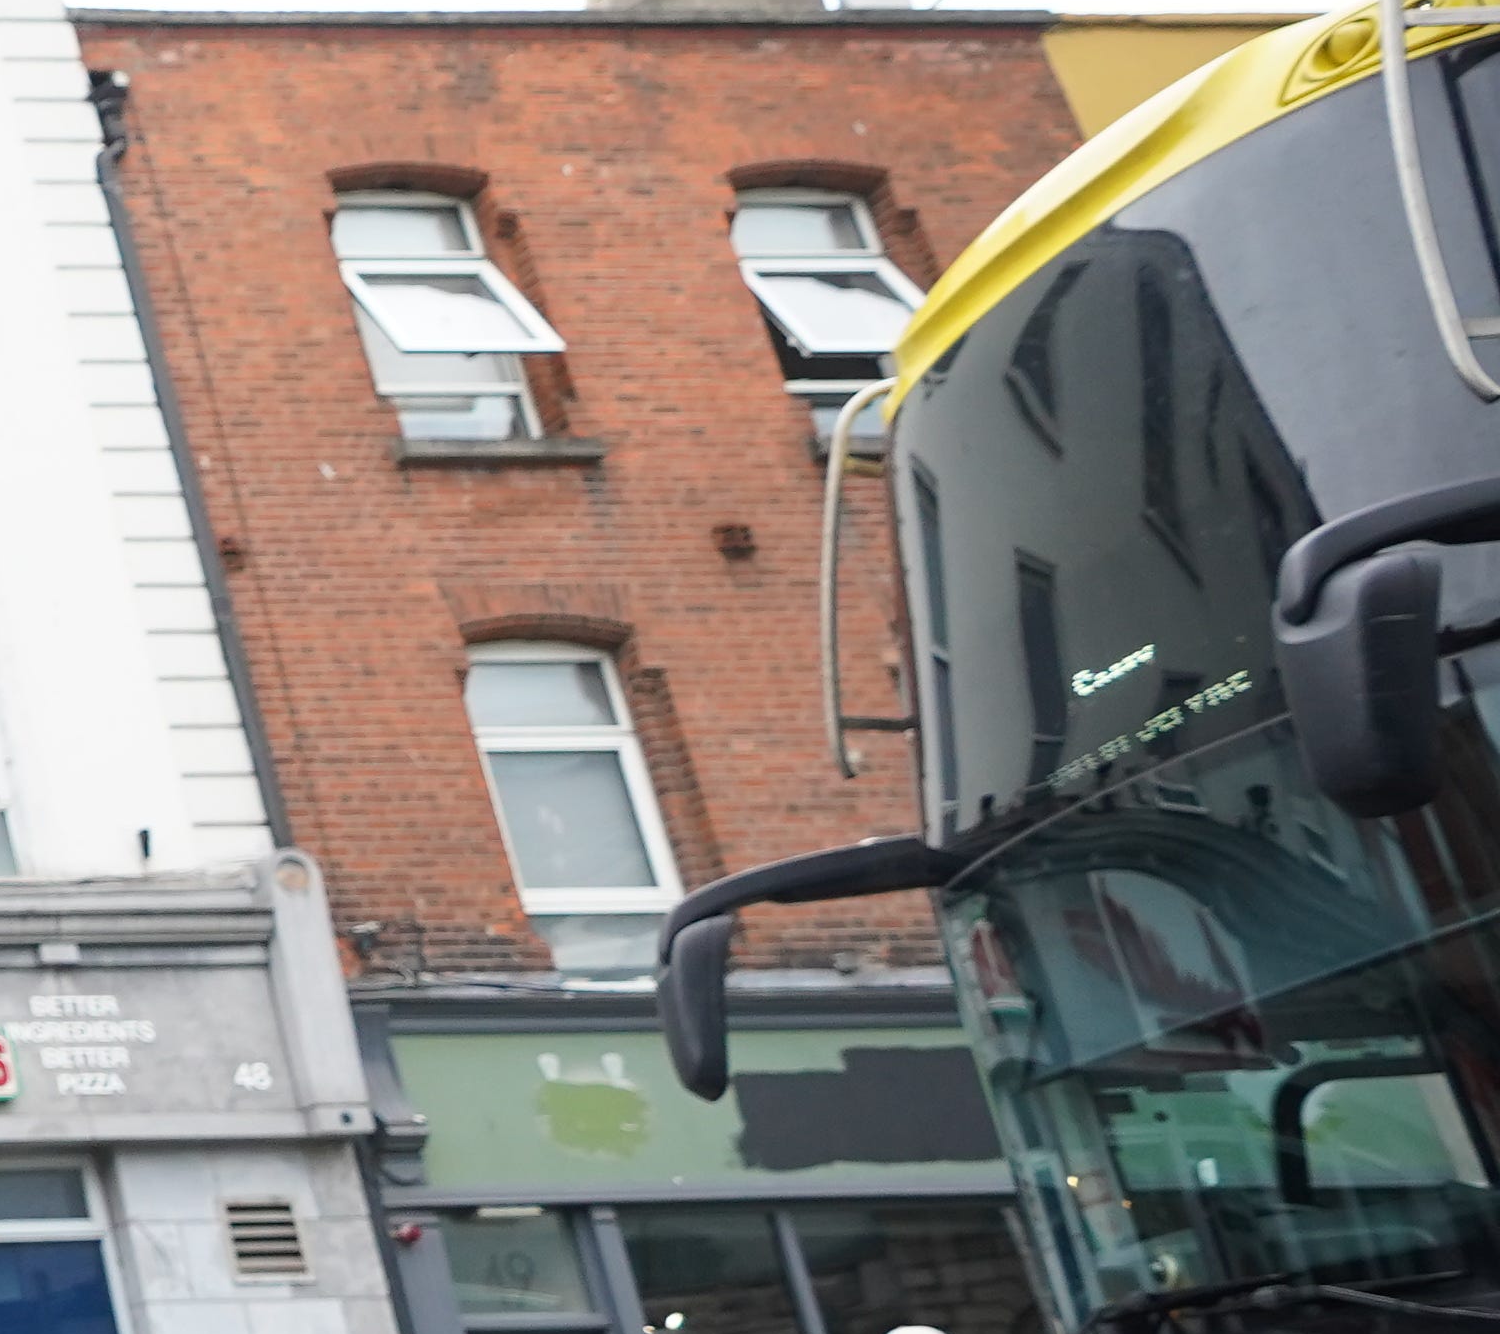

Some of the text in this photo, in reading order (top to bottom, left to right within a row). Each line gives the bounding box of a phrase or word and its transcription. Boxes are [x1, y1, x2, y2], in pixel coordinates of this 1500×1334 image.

[29, 995, 120, 1017] BETTER
[40, 1046, 131, 1069] BETTER
[56, 1072, 127, 1095] PIZZA
[233, 1061, 274, 1091] 48
